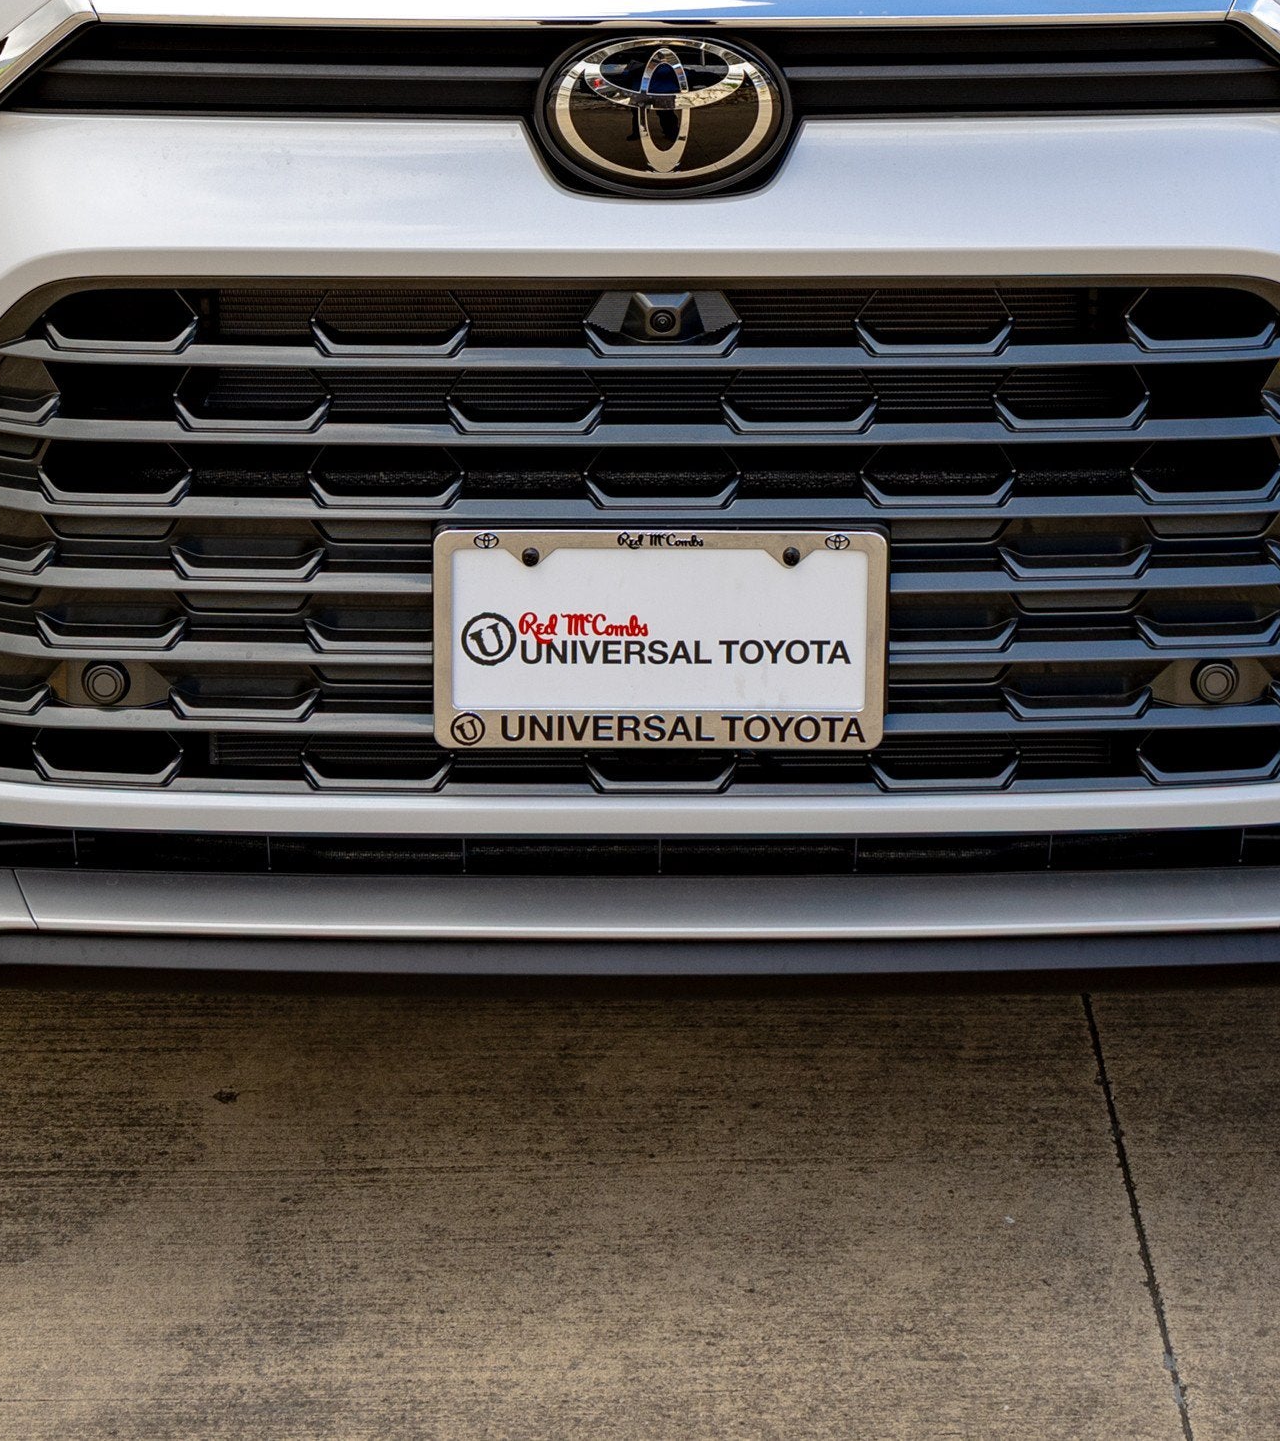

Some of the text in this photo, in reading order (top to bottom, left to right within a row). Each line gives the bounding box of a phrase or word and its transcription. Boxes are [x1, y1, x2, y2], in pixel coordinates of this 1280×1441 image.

[617, 531, 644, 550] Red
[519, 612, 558, 645] Red
[520, 639, 851, 665] UNIVERSAL TOYOTA
[500, 714, 866, 744] UNIVERSAL TOYOTA
